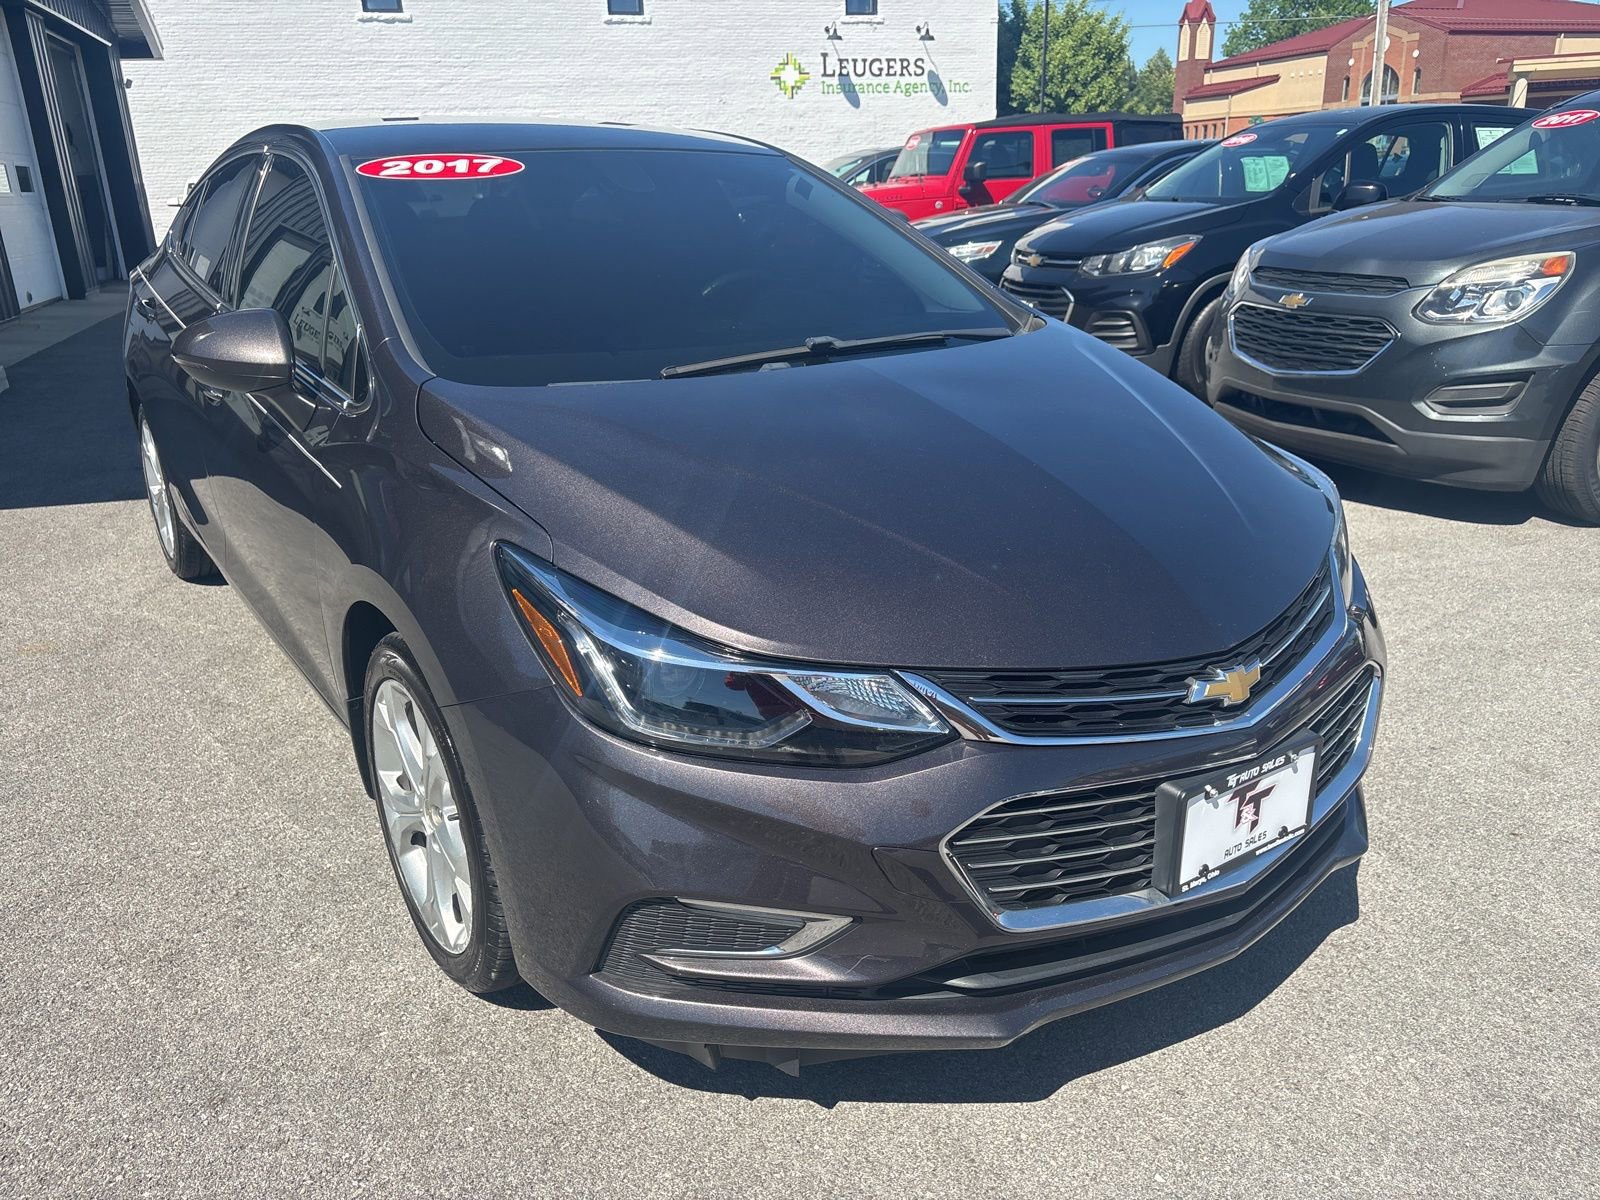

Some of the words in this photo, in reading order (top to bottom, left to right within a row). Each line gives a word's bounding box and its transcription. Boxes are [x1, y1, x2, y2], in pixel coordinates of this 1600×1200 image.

[820, 52, 925, 77] LEUGERS
[821, 81, 891, 95] Insurance
[948, 79, 972, 93] Inc.
[378, 158, 504, 176] 2017
[1239, 766, 1260, 783] AUTO
[1260, 755, 1286, 773] SALES
[1223, 842, 1243, 860] AUTO
[1244, 830, 1268, 848] SALES
